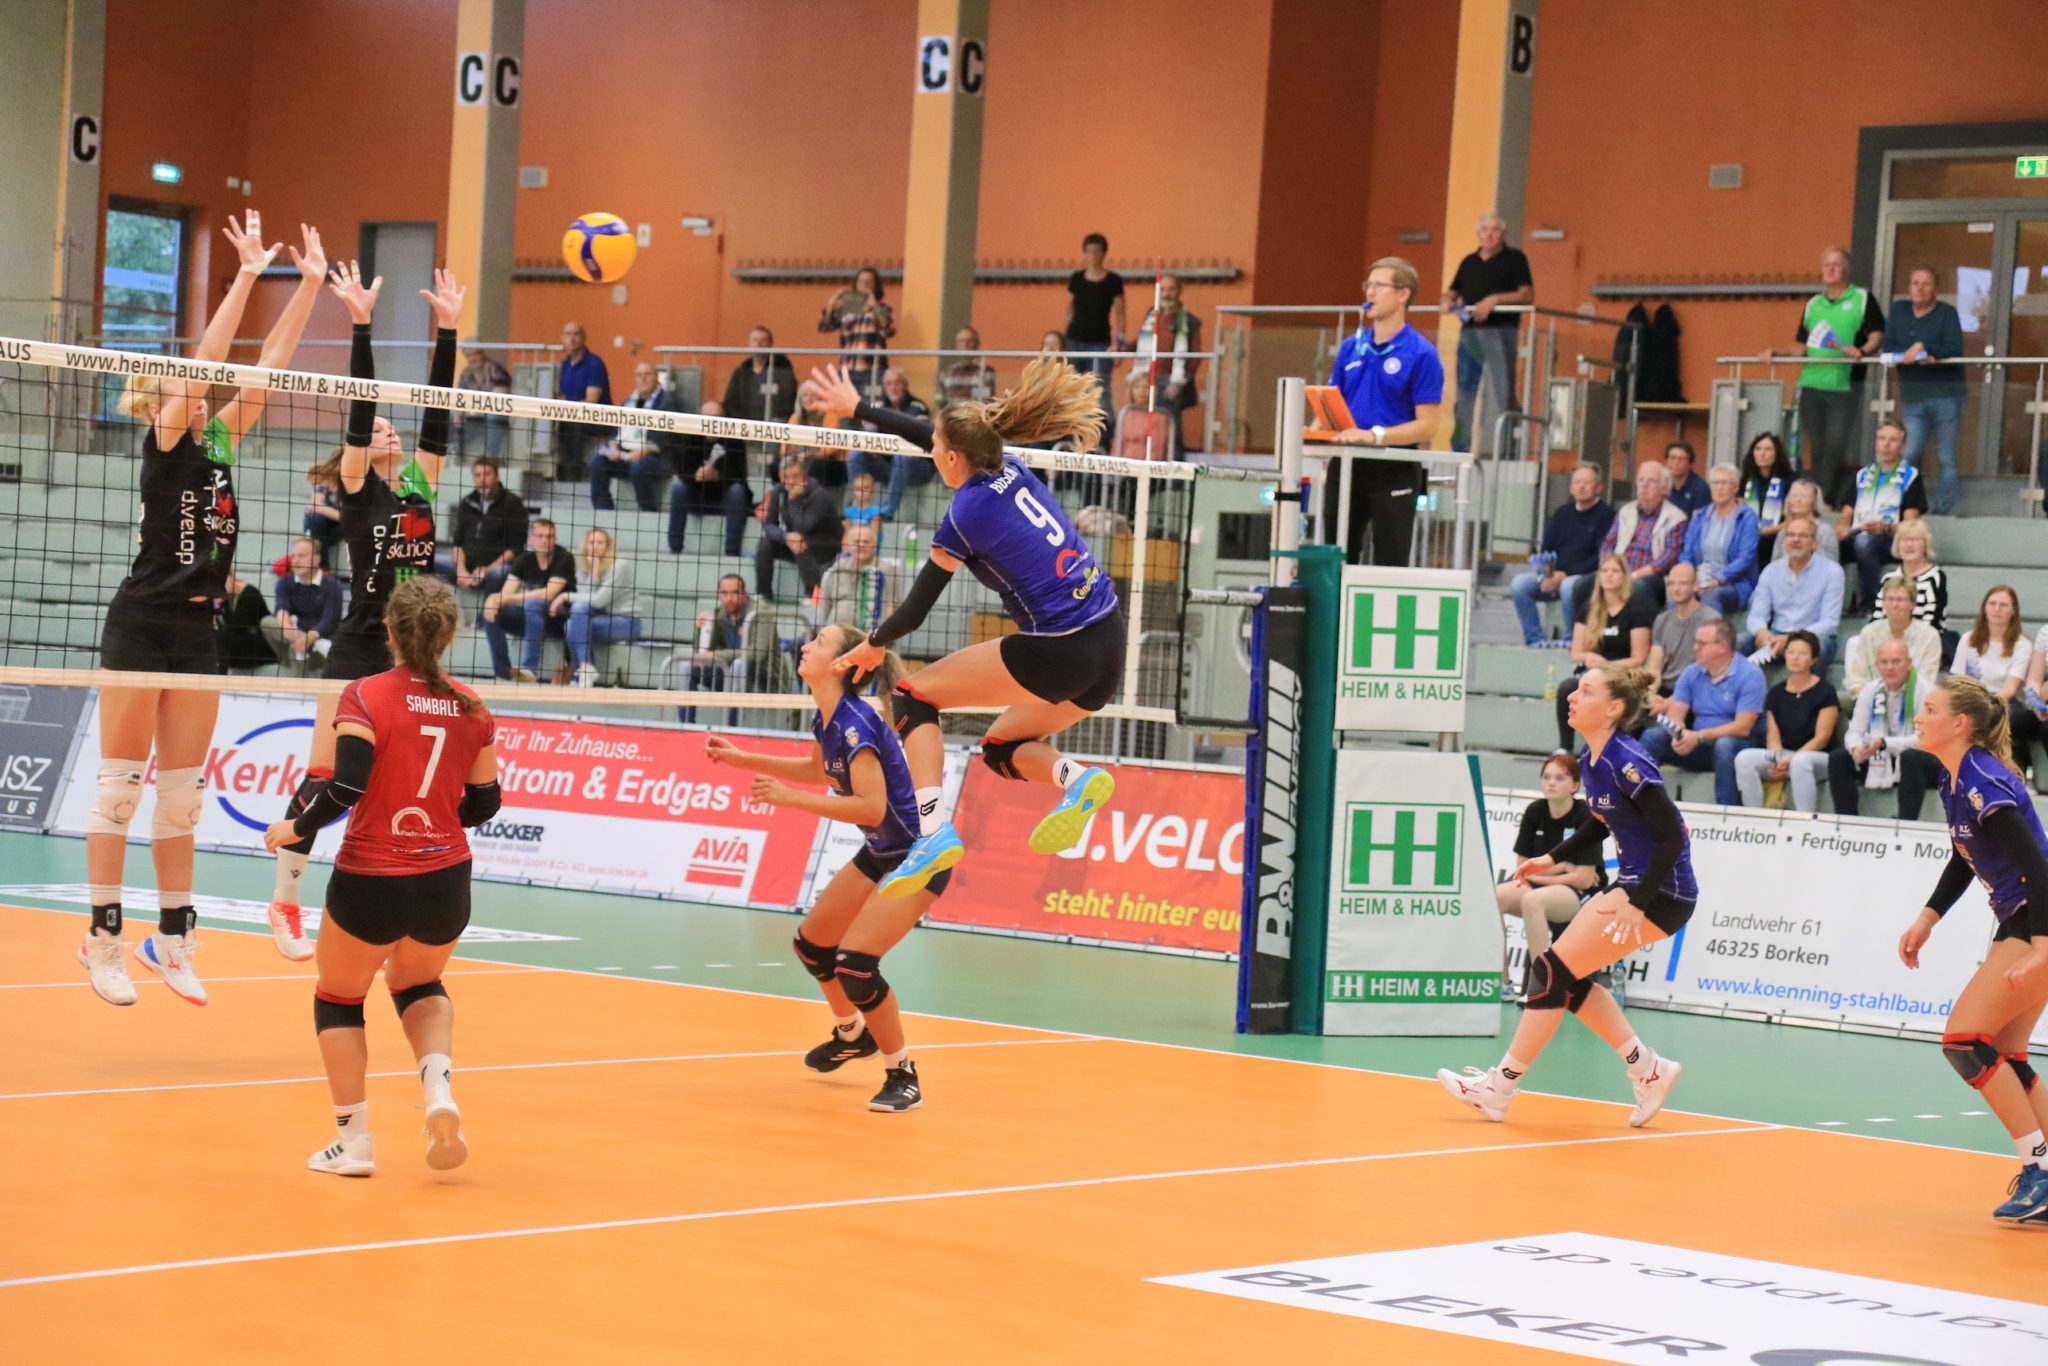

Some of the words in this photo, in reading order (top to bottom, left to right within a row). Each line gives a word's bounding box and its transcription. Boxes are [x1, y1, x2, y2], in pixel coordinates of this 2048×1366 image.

[1511, 14, 1533, 74] B
[922, 39, 948, 89] C
[961, 41, 983, 93] C
[461, 55, 483, 102] C
[496, 56, 518, 106] C
[73, 116, 97, 162] C
[66, 351, 236, 384] www.heimhaus.de
[268, 372, 312, 393] HEIM
[317, 379, 329, 395] &
[334, 380, 380, 400] HAUS
[410, 387, 450, 407] HEIM
[456, 394, 466, 408] &
[471, 396, 513, 413] HAUS
[540, 404, 676, 430] www.heimhaus.de
[701, 418, 736, 437] HEIM
[740, 423, 750, 437] &
[754, 425, 791, 441] HAUS
[815, 431, 848, 447] HEIM
[852, 435, 861, 448] &
[865, 436, 900, 452] HAUS
[1054, 455, 1084, 469] HEIM
[1087, 459, 1095, 471] &
[1099, 460, 1129, 474] HAUS
[1014, 486, 1065, 547] 9
[1341, 681, 1390, 699] HEIM
[1395, 683, 1407, 699] &
[1412, 683, 1463, 701] HAUS
[406, 695, 461, 717] SAMBALE
[494, 727, 526, 751] Für
[528, 730, 555, 753] Ihr
[416, 724, 447, 799] 7
[496, 757, 574, 797] Strom
[583, 765, 606, 800] &
[616, 767, 732, 816] Erdgas
[1801, 832, 1887, 858] Fertigung
[1043, 888, 1114, 919] steht
[1116, 892, 1200, 927] hinter
[1340, 898, 1387, 915] HEIM
[1392, 899, 1404, 915] &
[1410, 899, 1462, 916] HAUS
[1711, 911, 1797, 934] Landwehr
[1801, 919, 1822, 937] 61
[1705, 939, 1759, 959] 46325
[1764, 944, 1830, 966] Borken
[1370, 977, 1419, 996] HEIM
[1424, 979, 1437, 996] &
[1221, 1270, 1728, 1357] BLEKER
